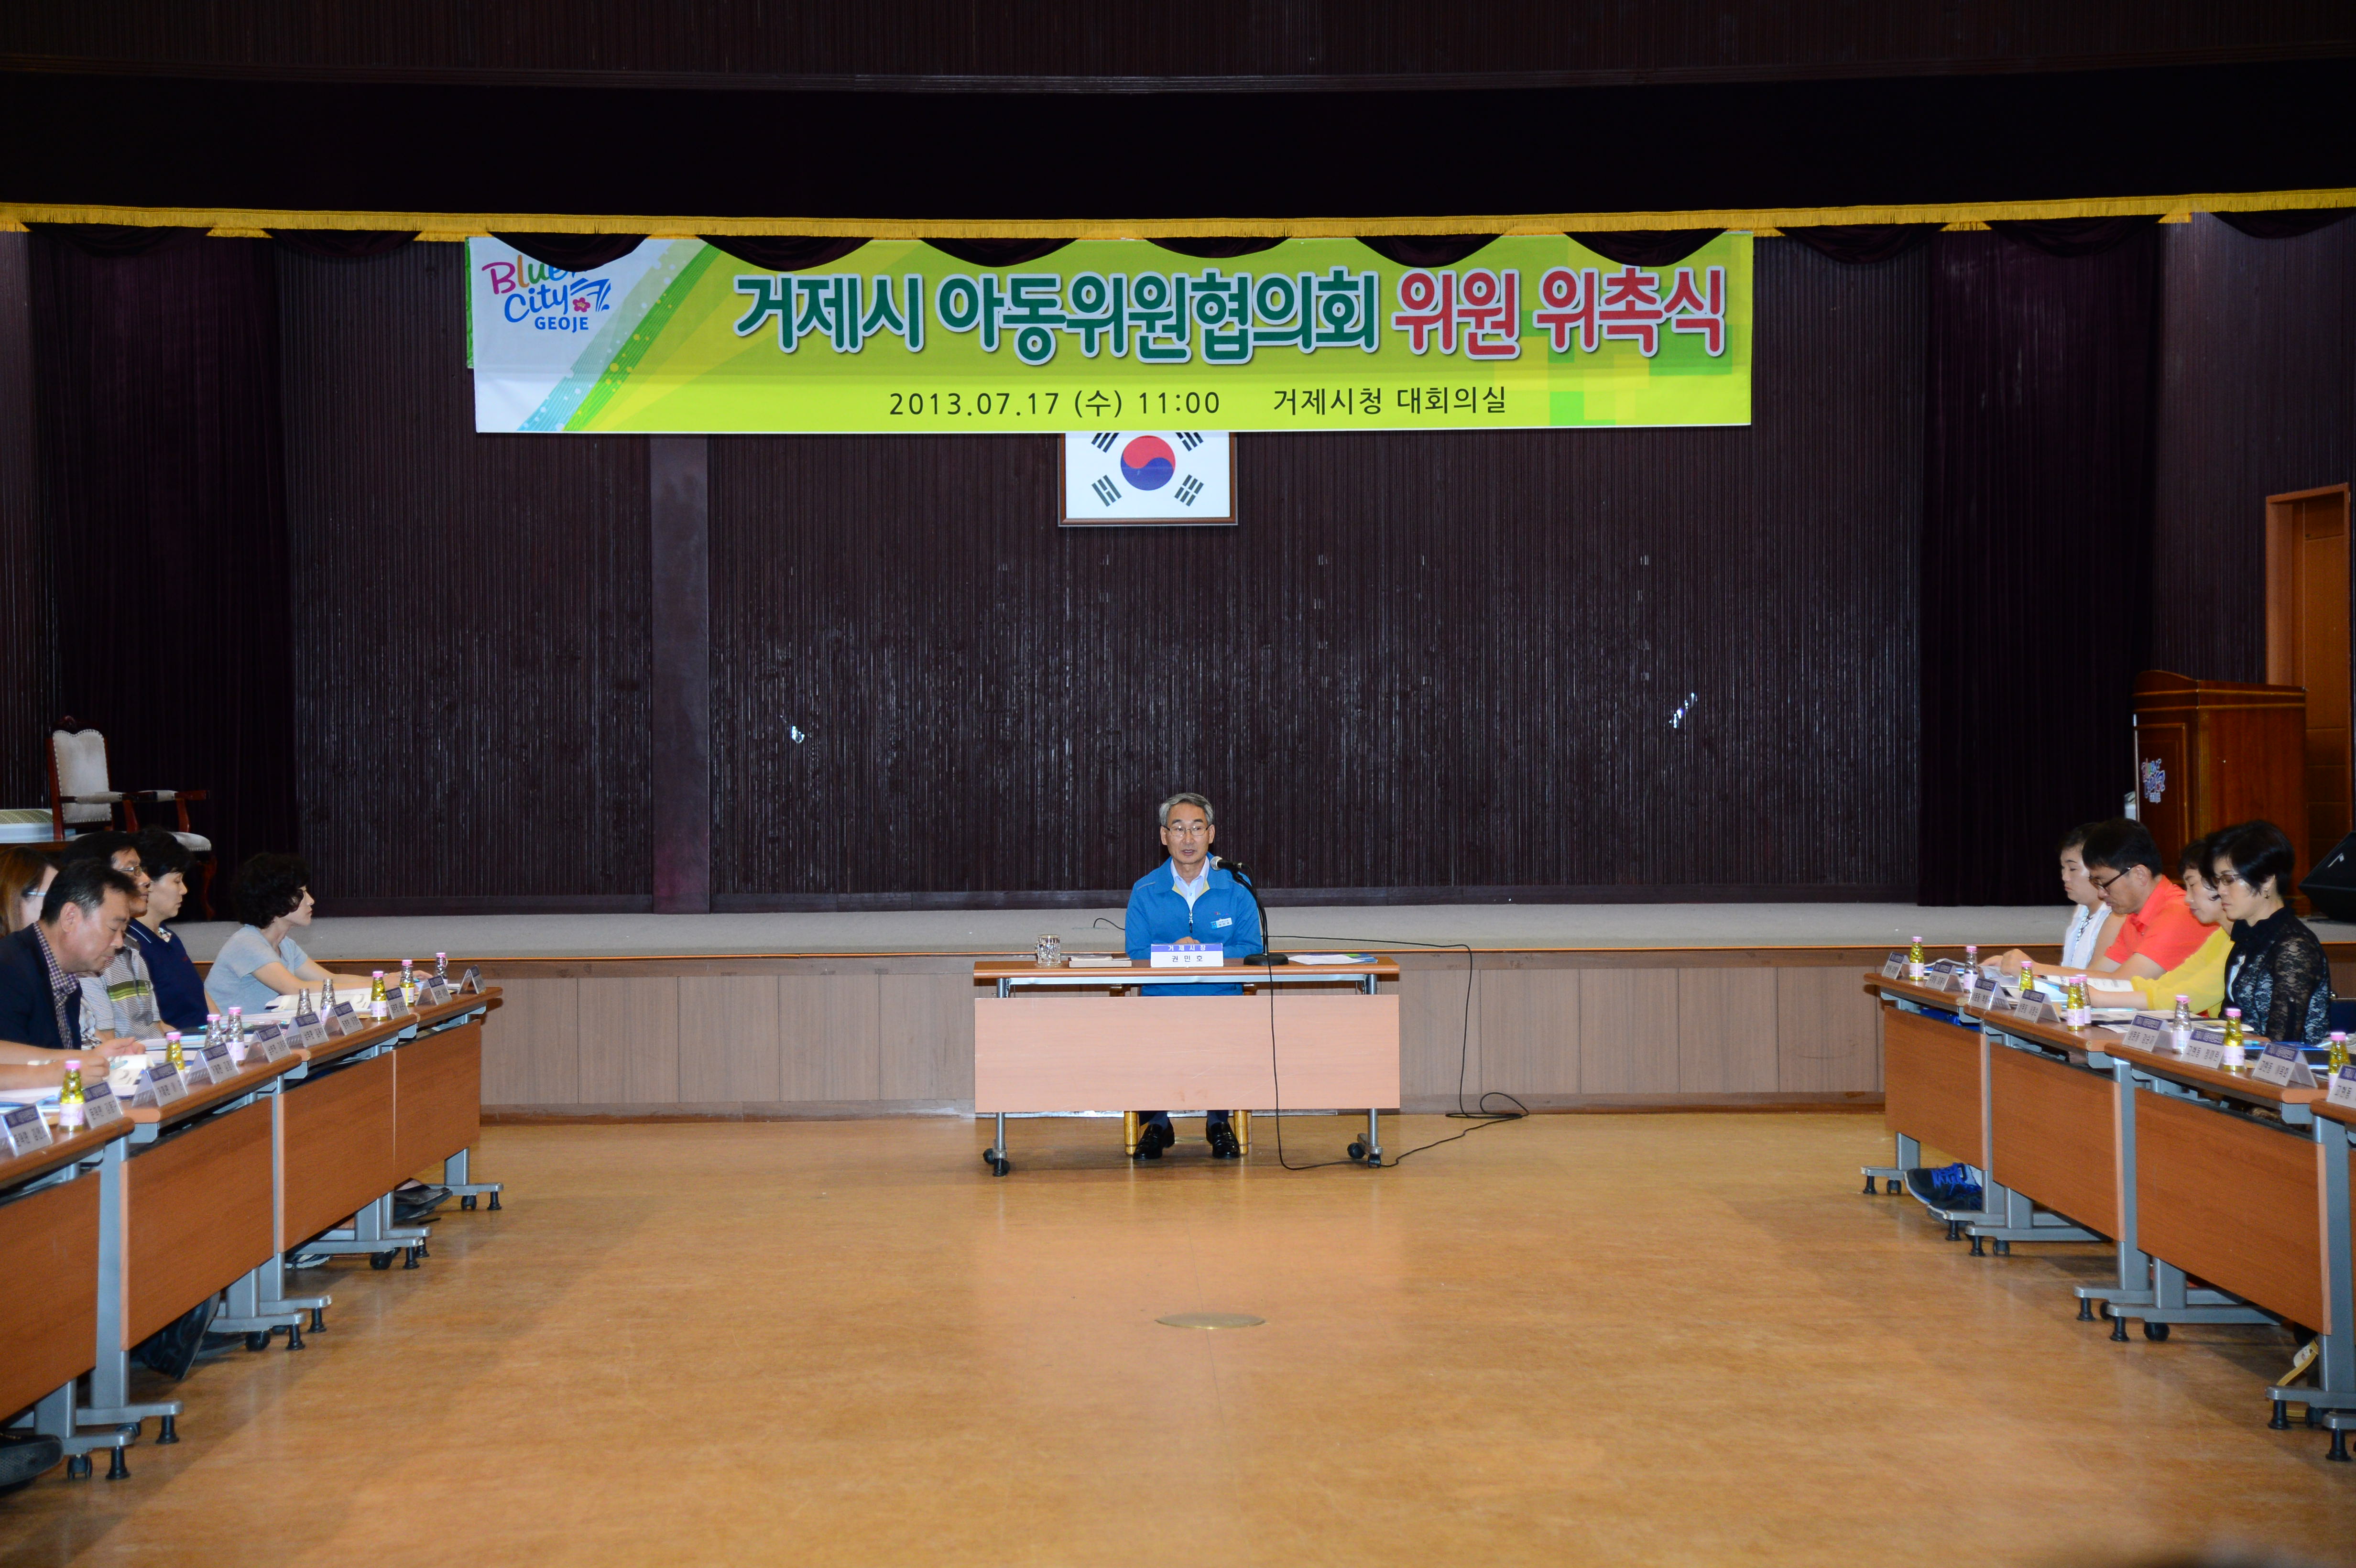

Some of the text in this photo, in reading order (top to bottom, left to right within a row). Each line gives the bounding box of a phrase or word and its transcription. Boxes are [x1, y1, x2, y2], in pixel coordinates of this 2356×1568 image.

[504, 283, 568, 323] City
[735, 267, 1723, 363] 거제시 아동위원협의회 위원 위촉식
[534, 316, 589, 333] GEOJE
[890, 386, 1505, 418] 2013.07.17 (수) 11:00 거제시청 대회의실
[1171, 955, 1203, 963] 권민호
